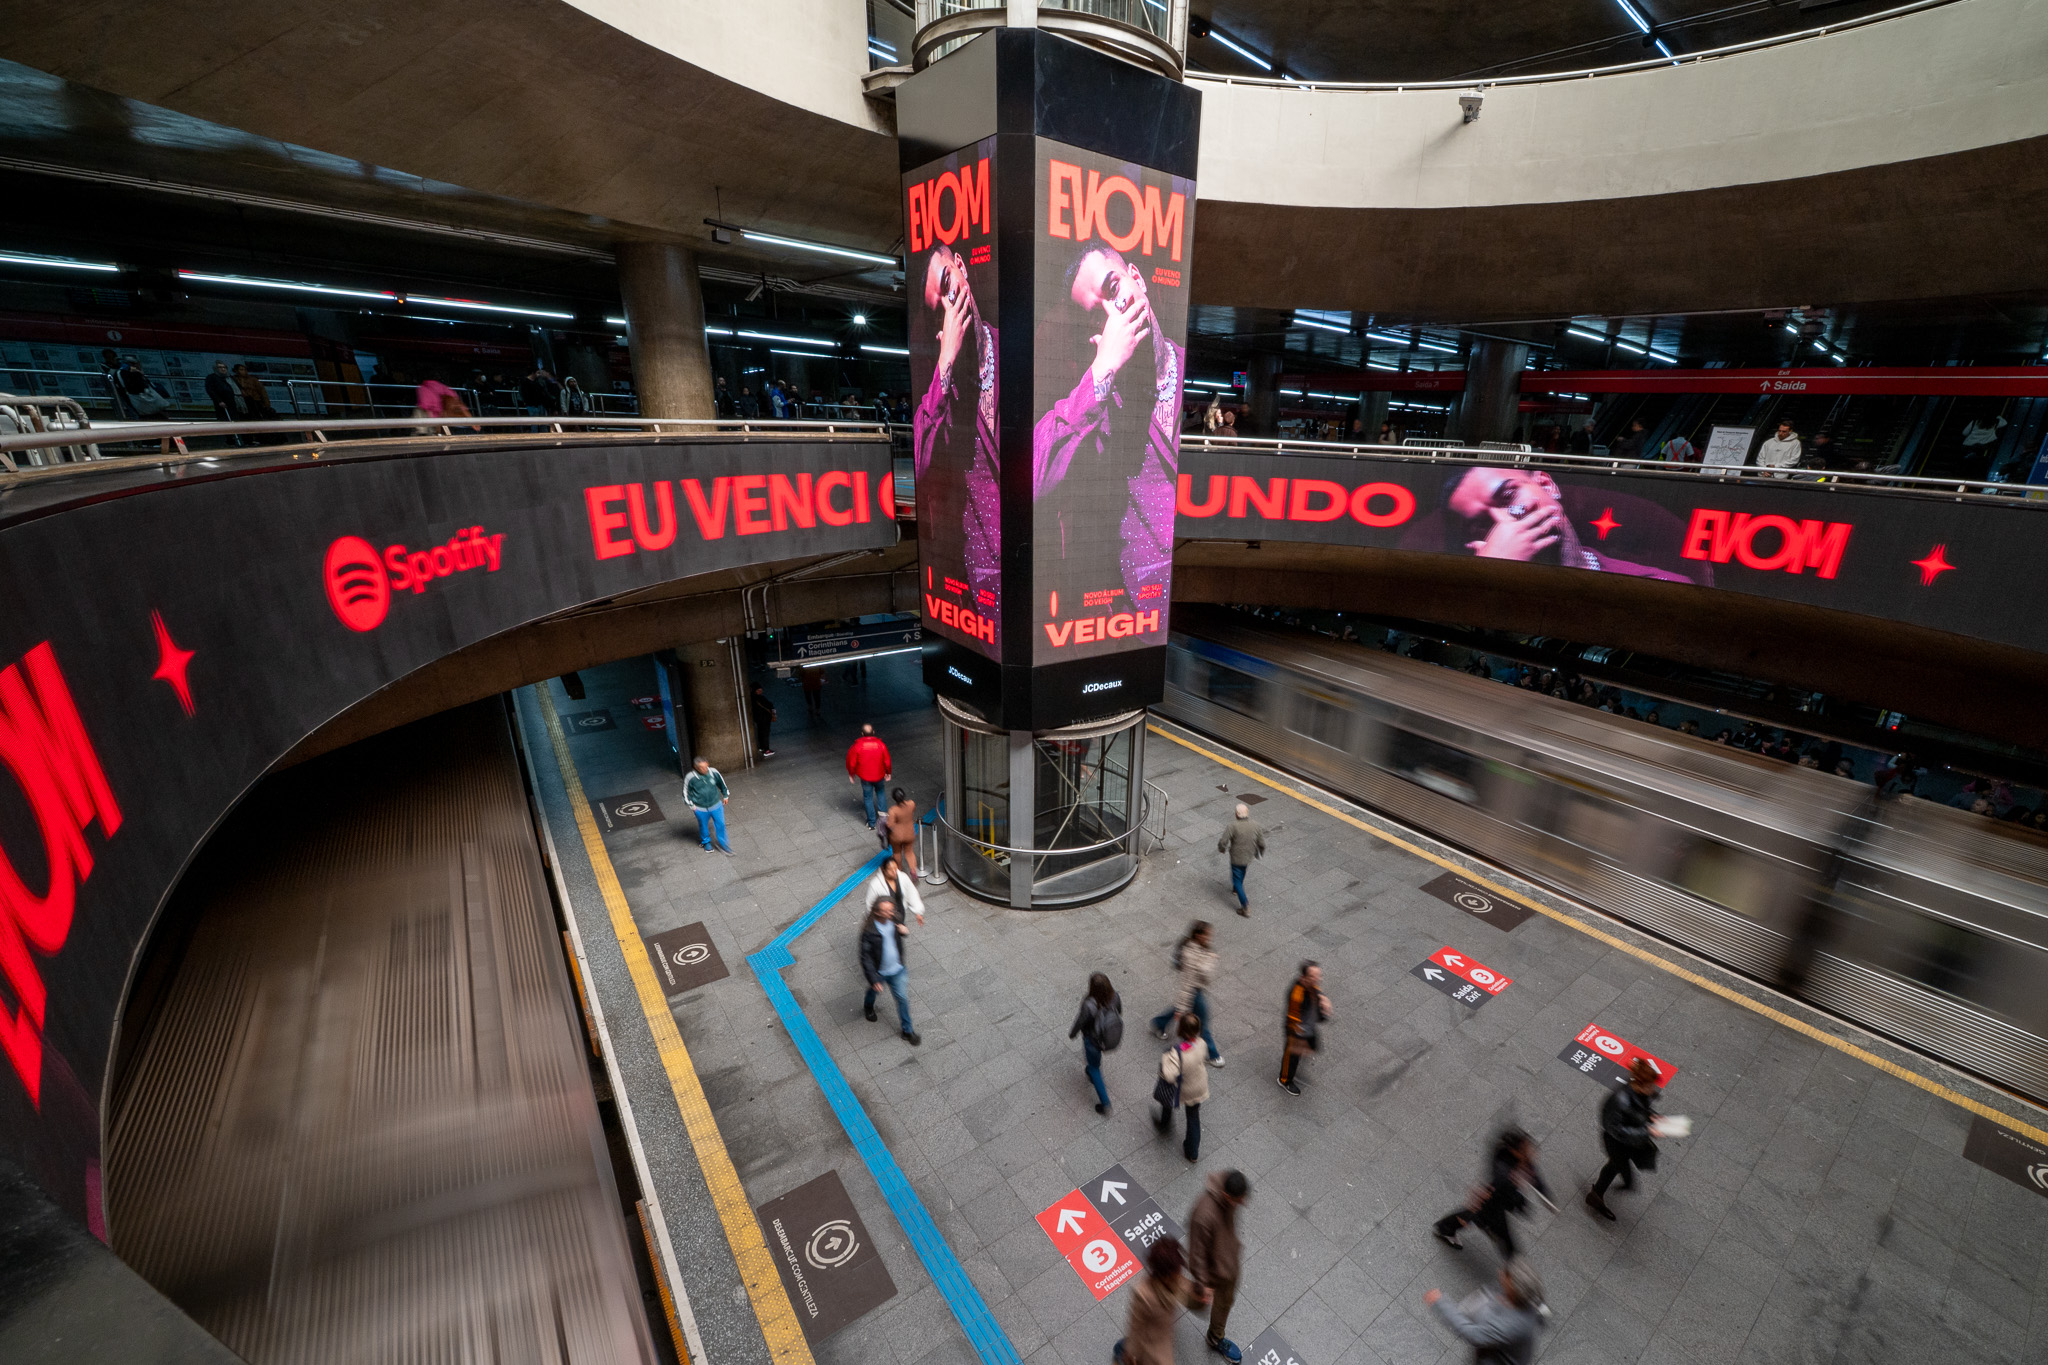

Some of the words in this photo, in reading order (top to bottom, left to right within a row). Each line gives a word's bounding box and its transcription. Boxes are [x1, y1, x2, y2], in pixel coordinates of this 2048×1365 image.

[909, 157, 990, 253] EVOM
[1049, 159, 1185, 262] EVOM
[1152, 275, 1157, 283] O
[1158, 276, 1180, 287] MUNDO
[1155, 267, 1163, 276] EU
[1164, 269, 1180, 279] VENCI
[1774, 381, 1806, 390] Saída
[1176, 473, 1416, 527] UNDO
[583, 480, 677, 560] EU
[681, 470, 870, 541] VENCI
[1680, 508, 1852, 579] EVOM
[384, 526, 503, 594] Spotify
[1084, 591, 1102, 600] NOVO
[1103, 588, 1124, 597] ÁLBUM
[1138, 591, 1162, 600] SPOTIFY
[1151, 584, 1162, 592] SEU
[1084, 599, 1093, 607] DO
[1094, 597, 1113, 606] VEIGH
[926, 594, 995, 645] VEIGH
[1044, 609, 1160, 647] VEIGH
[808, 640, 848, 650] Corinthians
[808, 648, 837, 657] Itaquera
[948, 665, 972, 685] JCDecaux
[1082, 680, 1122, 694] JCDecaux
[1475, 972, 1489, 980] 3
[1452, 984, 1475, 999] Saída
[1465, 991, 1481, 1003] Exit
[1601, 1039, 1617, 1050] 3
[1570, 1049, 1588, 1064] Exit
[1579, 1053, 1602, 1072] Saída
[1124, 1211, 1163, 1242] Saída
[1141, 1224, 1166, 1248] Exit
[1090, 1247, 1110, 1266] 3
[791, 1261, 805, 1283] COM
[1095, 1259, 1133, 1289] Corinthians
[1103, 1269, 1132, 1292] Itaquera
